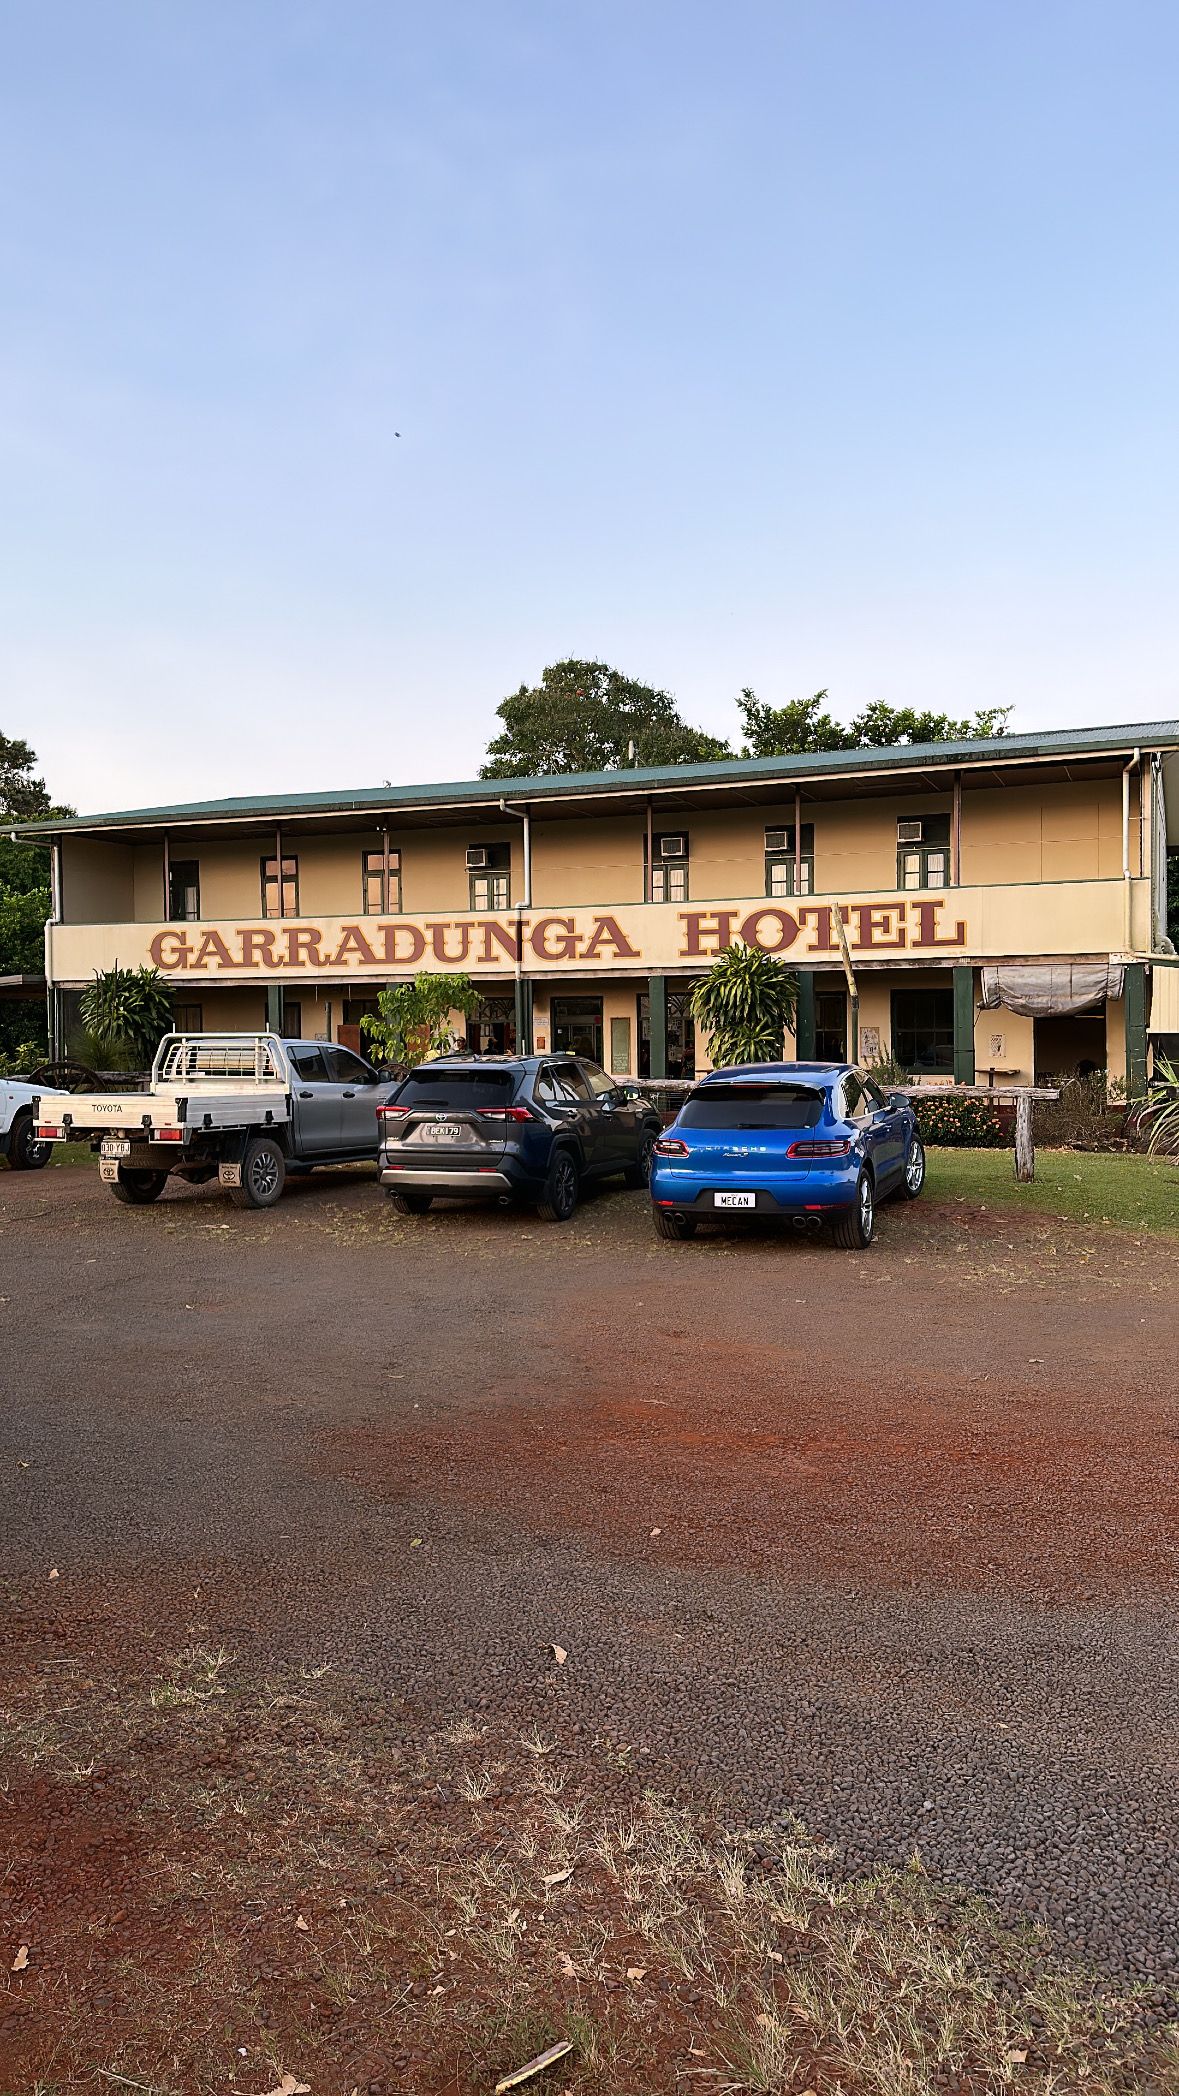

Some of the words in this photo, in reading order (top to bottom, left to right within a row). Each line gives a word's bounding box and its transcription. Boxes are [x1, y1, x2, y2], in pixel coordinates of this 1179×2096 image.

[148, 915, 642, 971] GARRADUNGA
[678, 899, 968, 957] HOTEL
[92, 1104, 123, 1113] TOYOTA
[721, 1196, 749, 1206] MECAN
